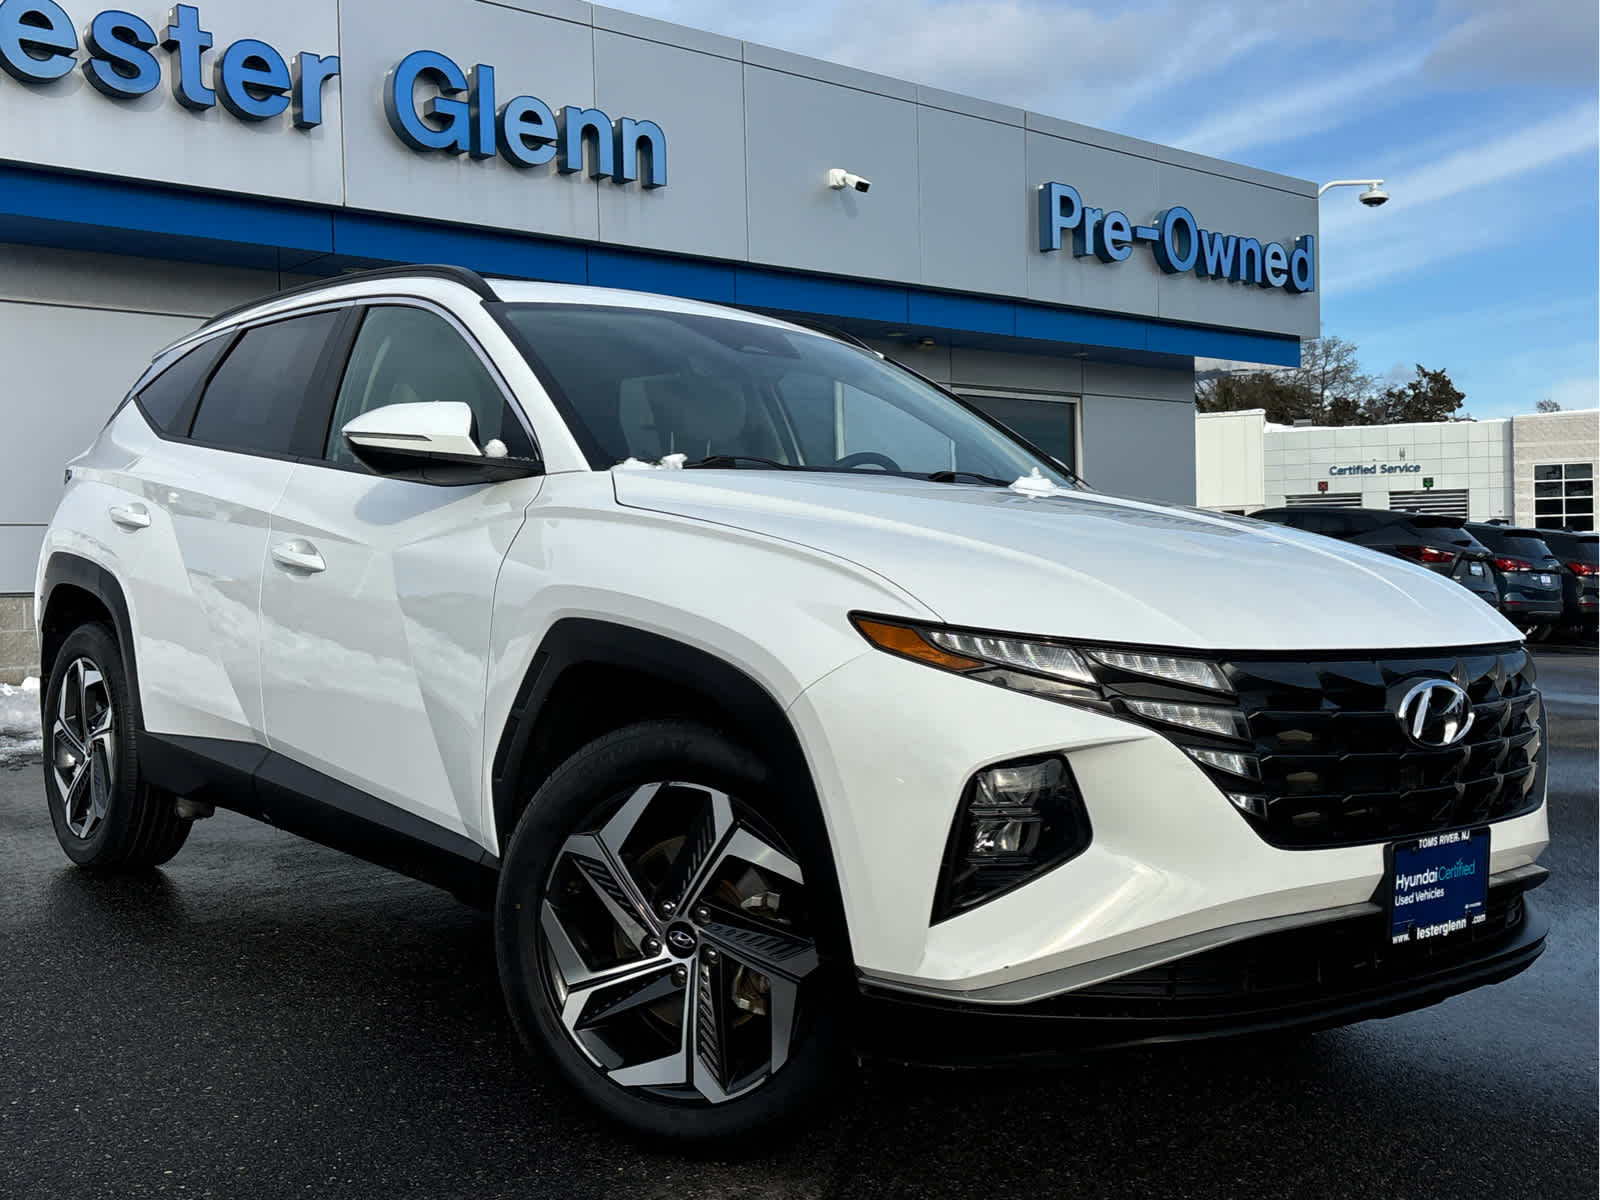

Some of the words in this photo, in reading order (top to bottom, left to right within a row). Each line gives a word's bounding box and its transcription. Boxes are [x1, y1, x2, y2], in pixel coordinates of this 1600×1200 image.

[0, 0, 340, 129] ester
[384, 49, 667, 189] Glenn
[1039, 181, 1315, 293] Pre-Owned
[1329, 464, 1377, 476] Certified
[1380, 463, 1421, 474] Service
[1418, 836, 1438, 849] TOMS
[1461, 830, 1470, 841] NJ
[1394, 893, 1414, 907] Used
[1415, 887, 1445, 902] Vehicles
[1416, 918, 1467, 940] lesterglenn
